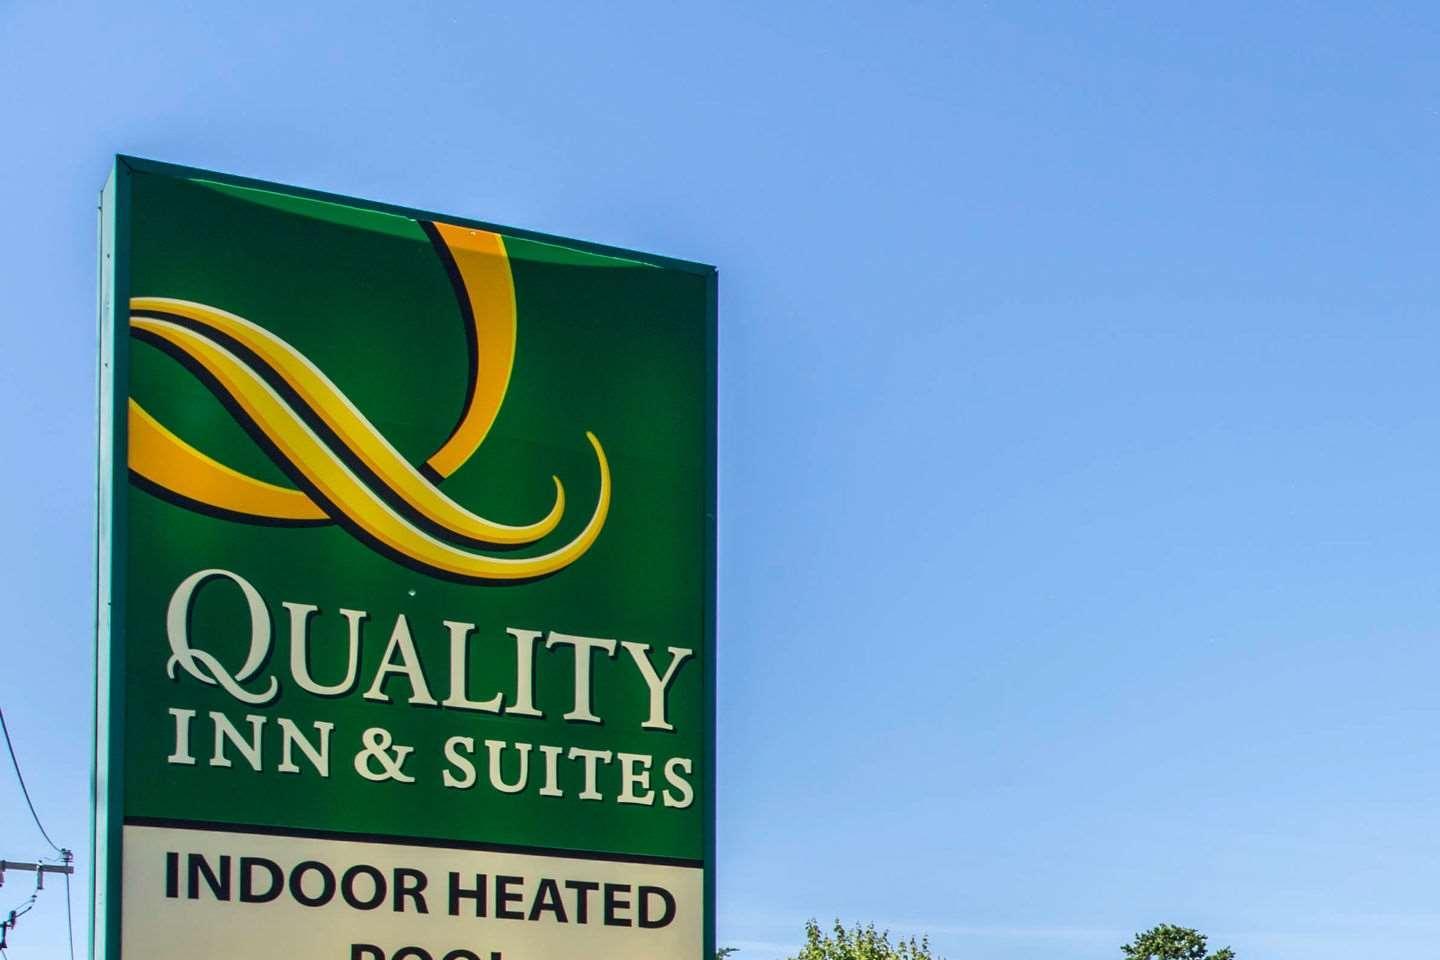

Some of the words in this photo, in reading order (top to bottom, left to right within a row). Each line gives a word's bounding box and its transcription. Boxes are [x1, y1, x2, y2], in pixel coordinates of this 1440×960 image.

[166, 568, 694, 731] QUALITY
[167, 707, 335, 777] INN
[354, 727, 415, 783] &
[443, 735, 694, 809] SUITES
[165, 851, 430, 915] INDOOR
[448, 871, 677, 929] HEATED
